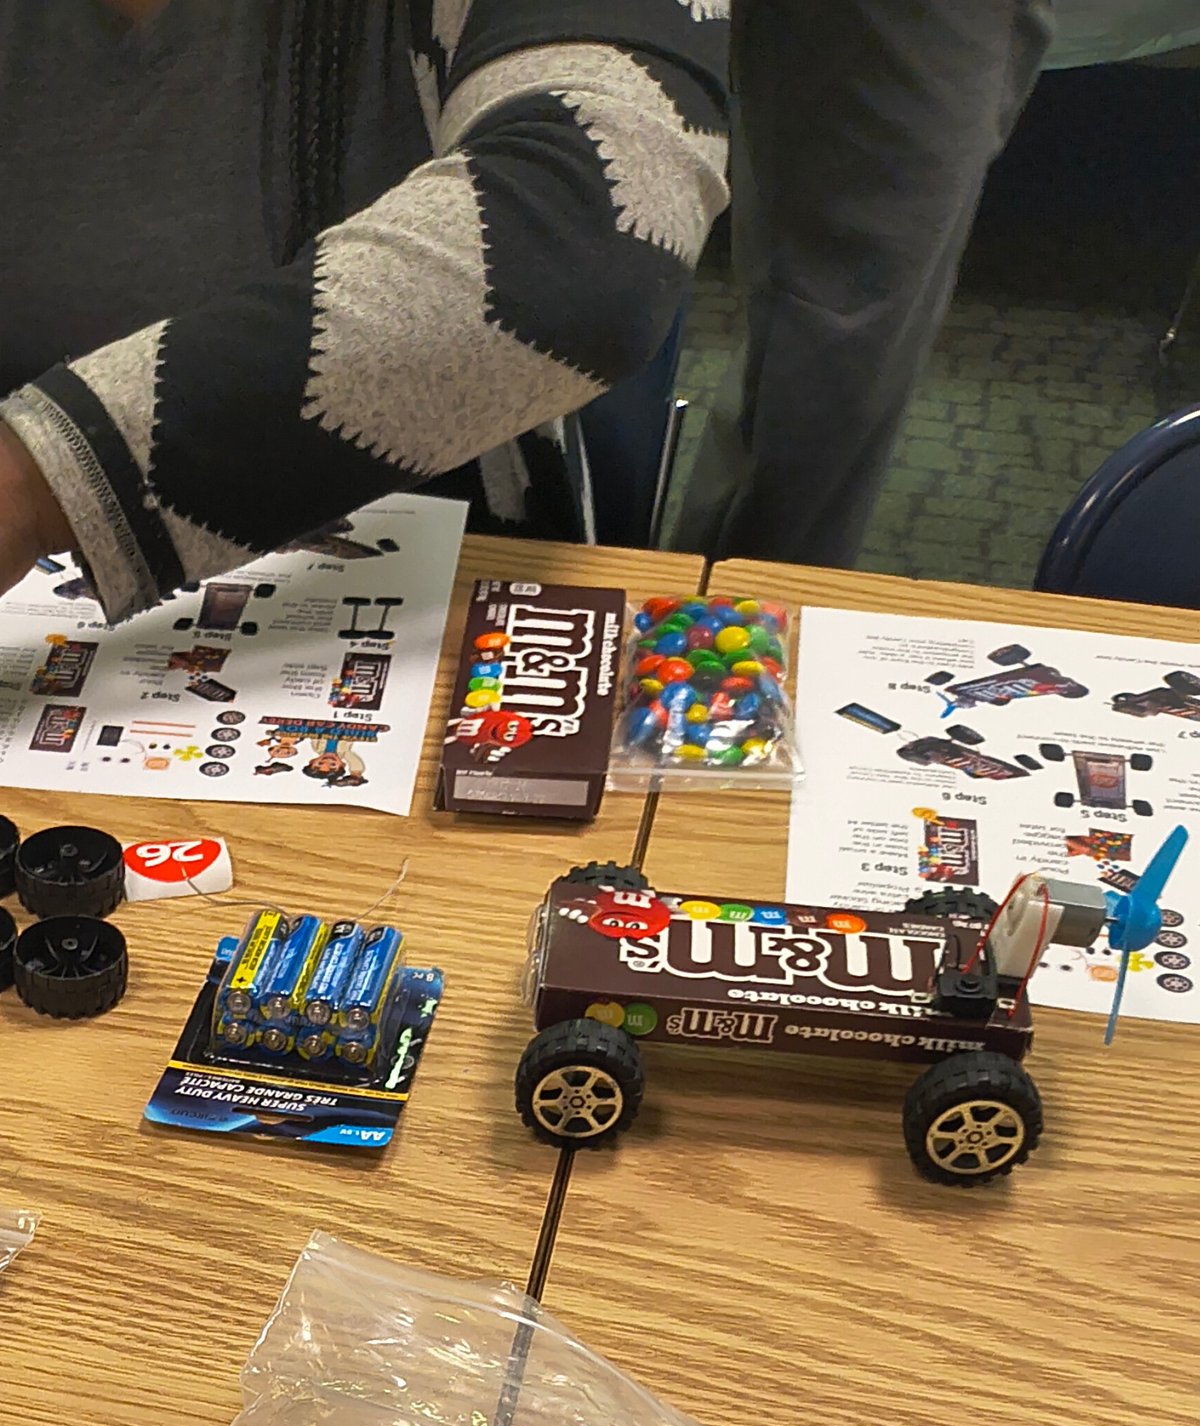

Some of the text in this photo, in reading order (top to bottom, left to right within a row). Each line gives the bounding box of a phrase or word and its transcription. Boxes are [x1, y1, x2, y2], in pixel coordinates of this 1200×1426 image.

[499, 604, 595, 736] m&m's
[900, 682, 932, 694] Step
[151, 692, 181, 702] Step
[343, 711, 373, 721] Step
[942, 792, 987, 805] Step 6
[1080, 810, 1127, 822] Step 5
[136, 840, 204, 867] 26
[861, 862, 908, 876] Step 3
[619, 915, 946, 996] m&m's
[727, 987, 876, 1015] chocolate
[666, 1007, 778, 1044] m&m's
[785, 1023, 986, 1053] milk chocolate
[179, 1076, 244, 1093] CAPACITÉ
[175, 1085, 307, 1112] SUPER HEAVY DUTY
[246, 1085, 303, 1102] GRANDE
[303, 1094, 338, 1107] TRÈS
[360, 1129, 387, 1141] AA
